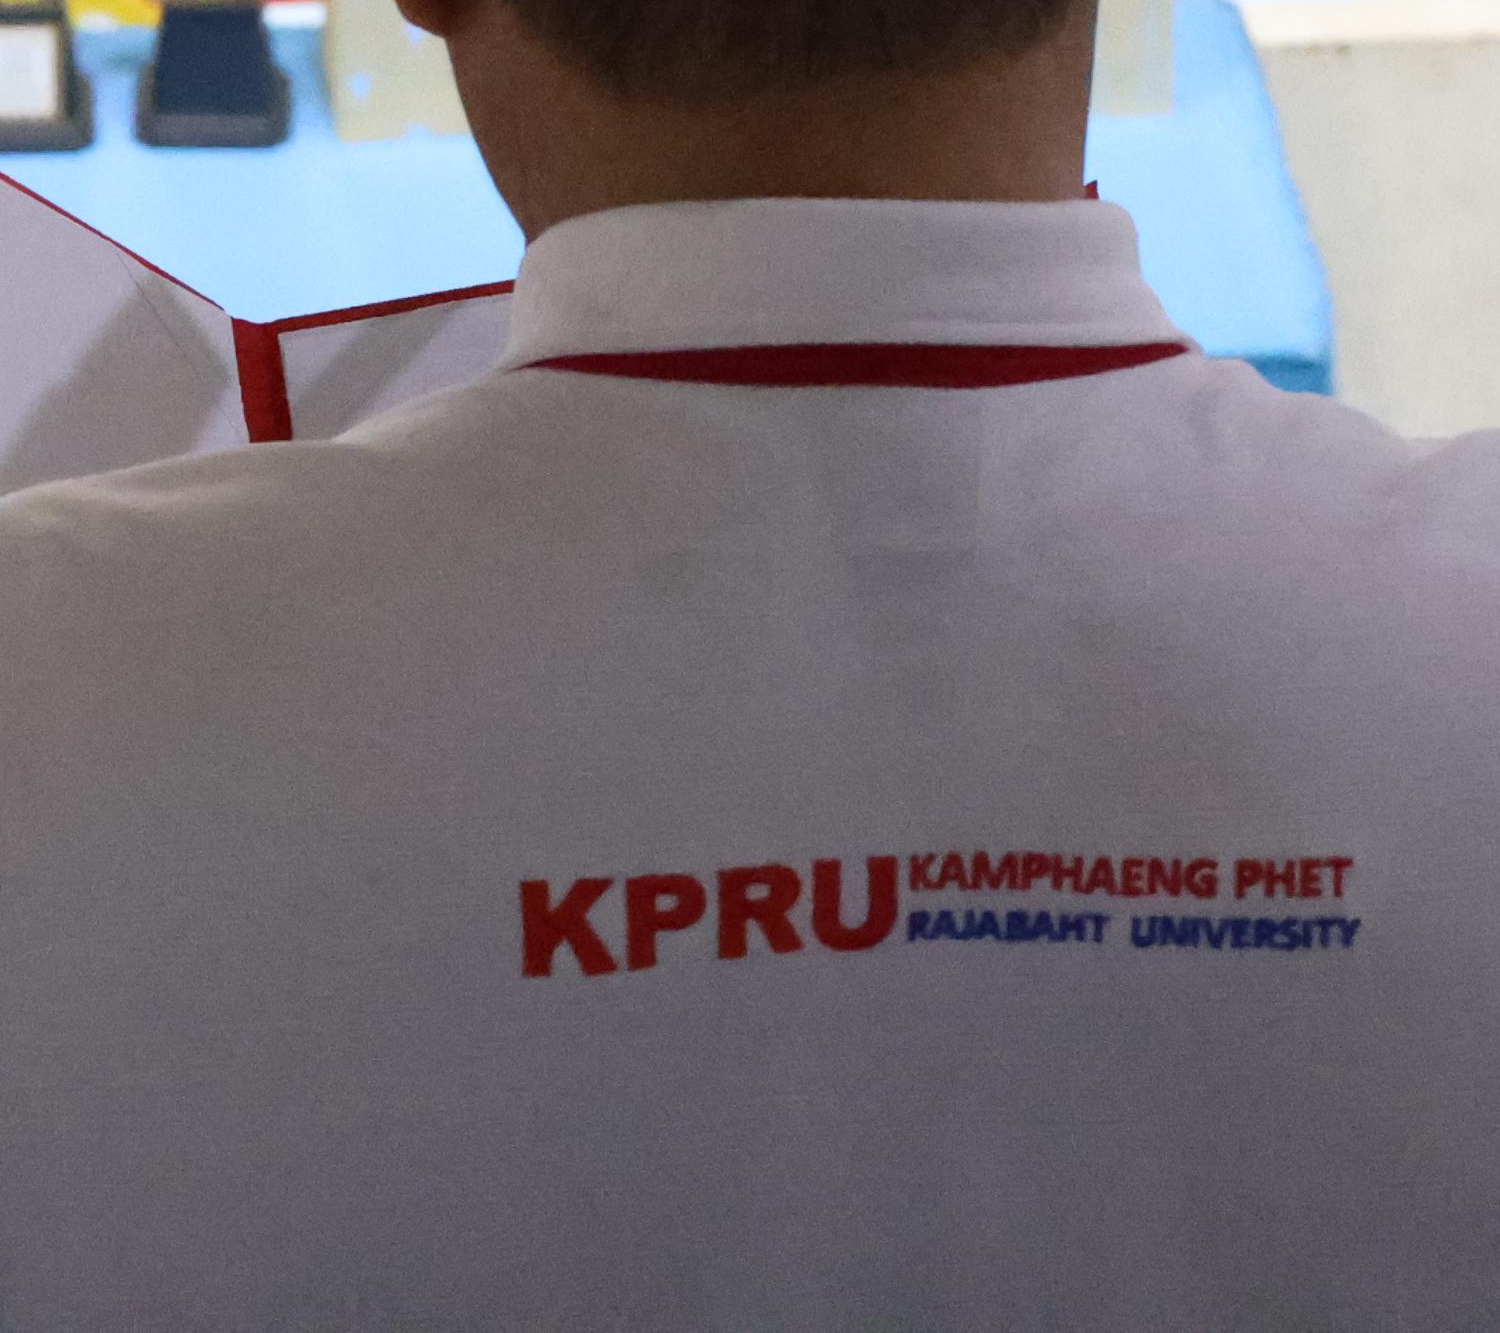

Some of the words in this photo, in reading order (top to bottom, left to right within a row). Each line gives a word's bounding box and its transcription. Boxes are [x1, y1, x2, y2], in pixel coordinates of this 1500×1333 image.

[519, 855, 899, 977] KPRU
[909, 850, 1218, 899] KAMPHAENG
[1234, 856, 1353, 899] PHET
[1129, 915, 1359, 951] UNIVERSITY
